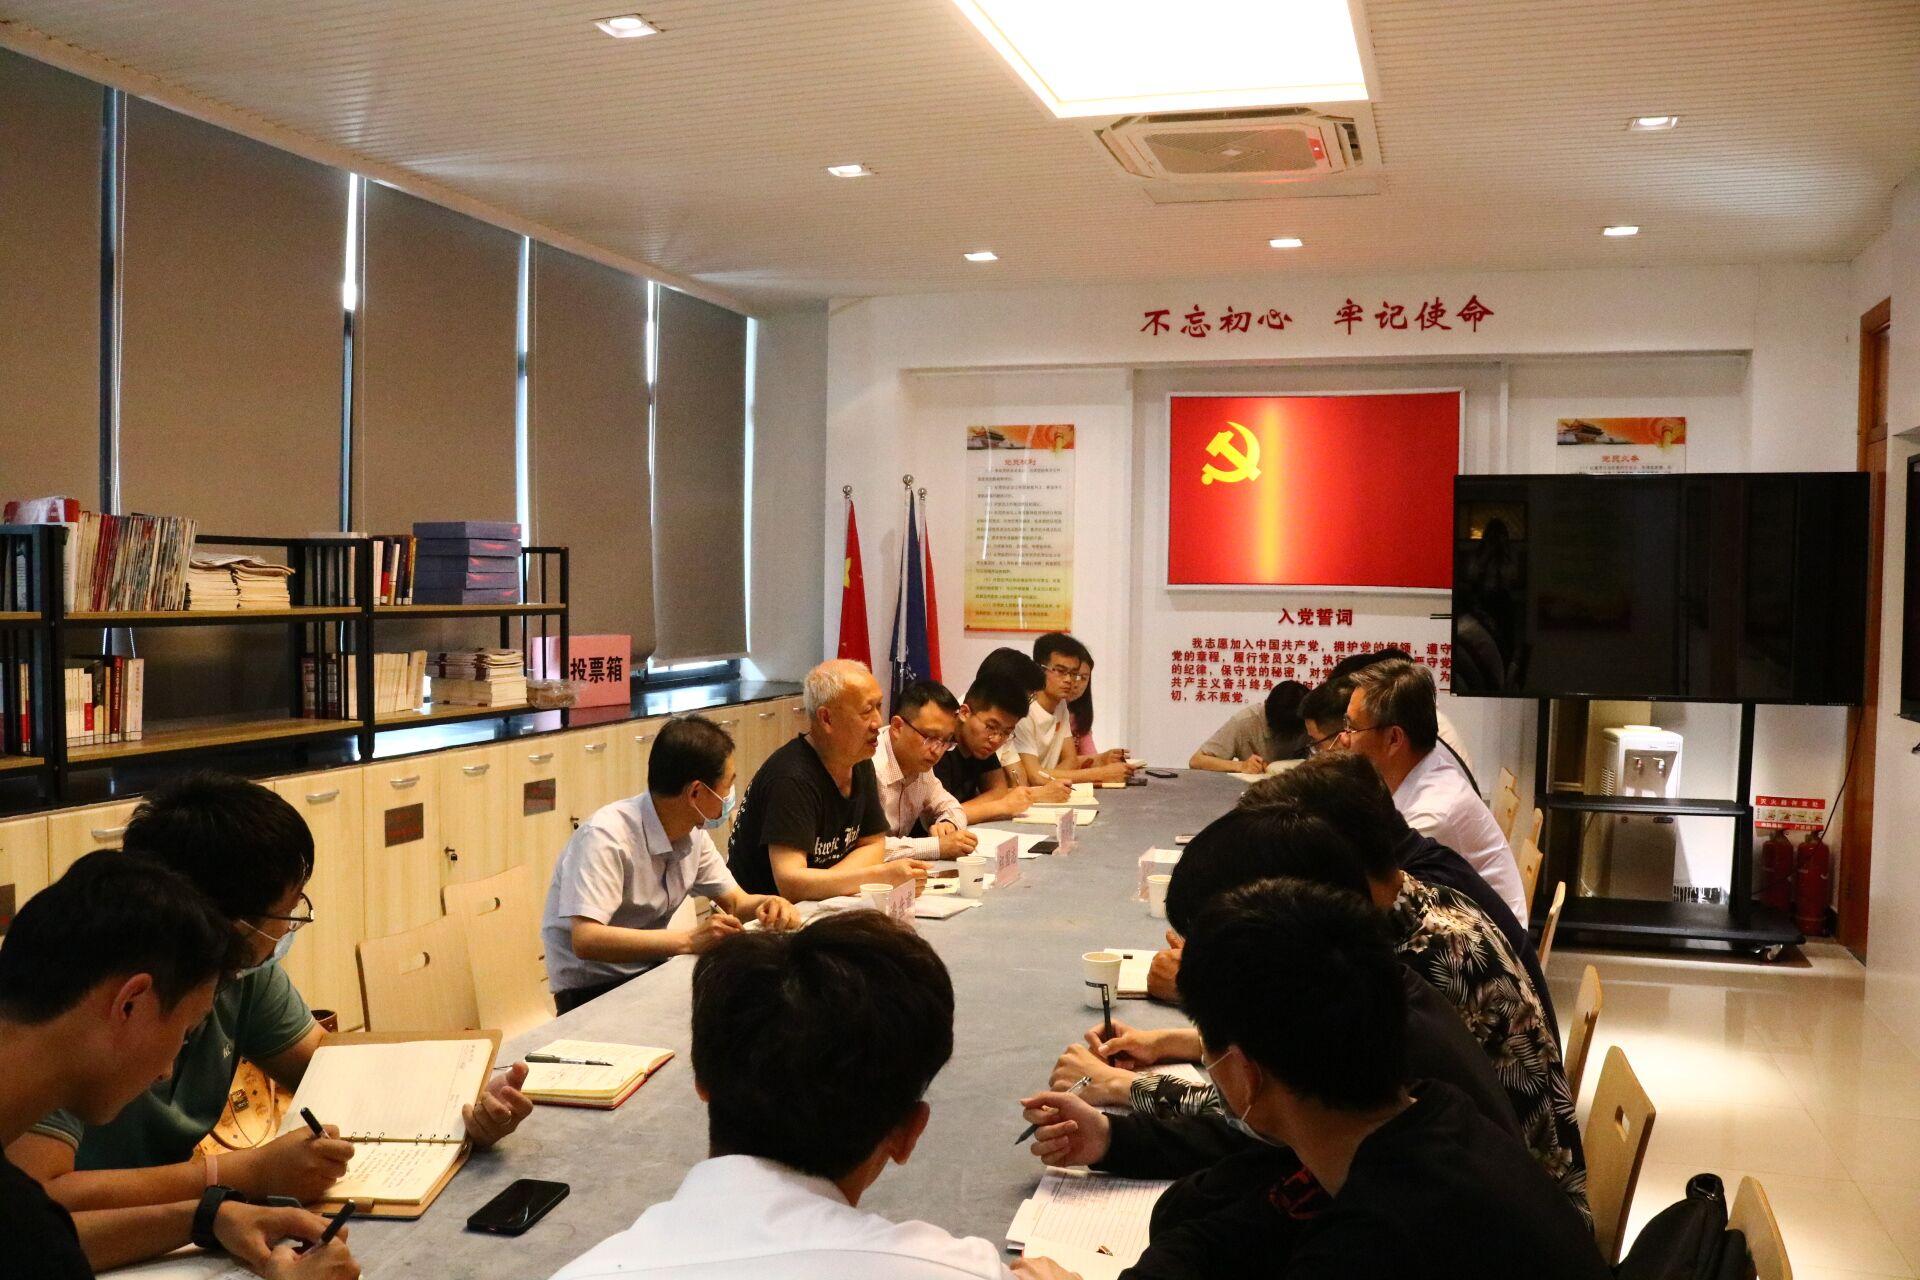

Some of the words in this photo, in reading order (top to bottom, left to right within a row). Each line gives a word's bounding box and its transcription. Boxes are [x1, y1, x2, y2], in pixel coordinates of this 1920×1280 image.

[1140, 304, 1292, 338] 不忘初心
[1334, 295, 1494, 335] 牢记使命
[1278, 608, 1354, 627] 入党誓词
[570, 656, 623, 684] 投票箱
